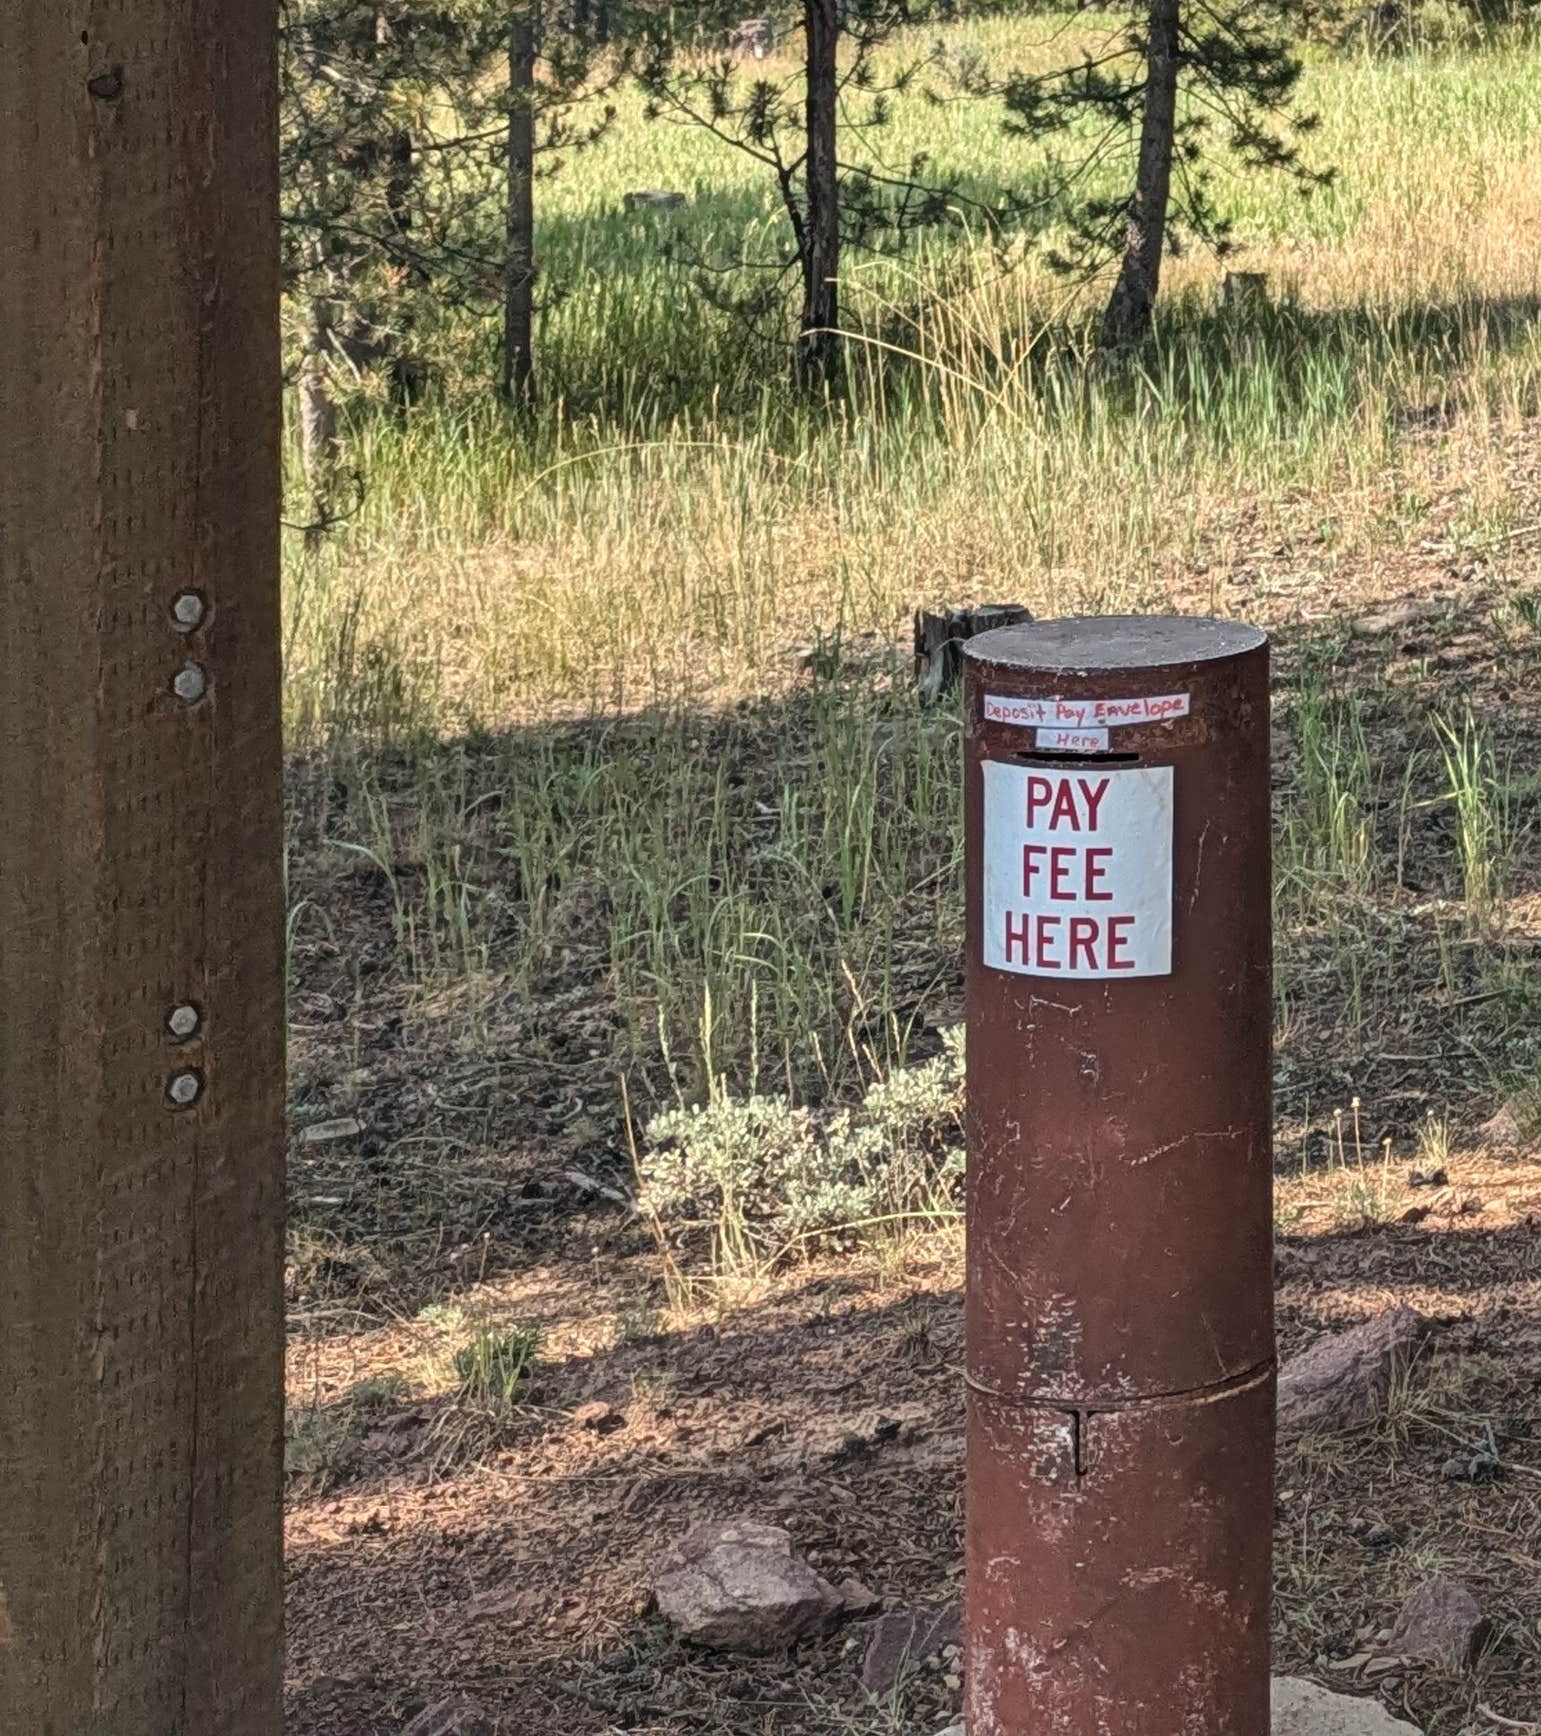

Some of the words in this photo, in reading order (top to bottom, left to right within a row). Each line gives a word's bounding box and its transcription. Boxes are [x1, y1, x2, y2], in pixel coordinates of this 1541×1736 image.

[986, 701, 1047, 722] Deposit
[1055, 702, 1086, 727] Pay
[1094, 696, 1185, 719] Envelope
[1057, 731, 1100, 747] Here
[1025, 775, 1111, 832] PAY
[1023, 843, 1113, 901] FEE
[1004, 909, 1135, 970] HERE
